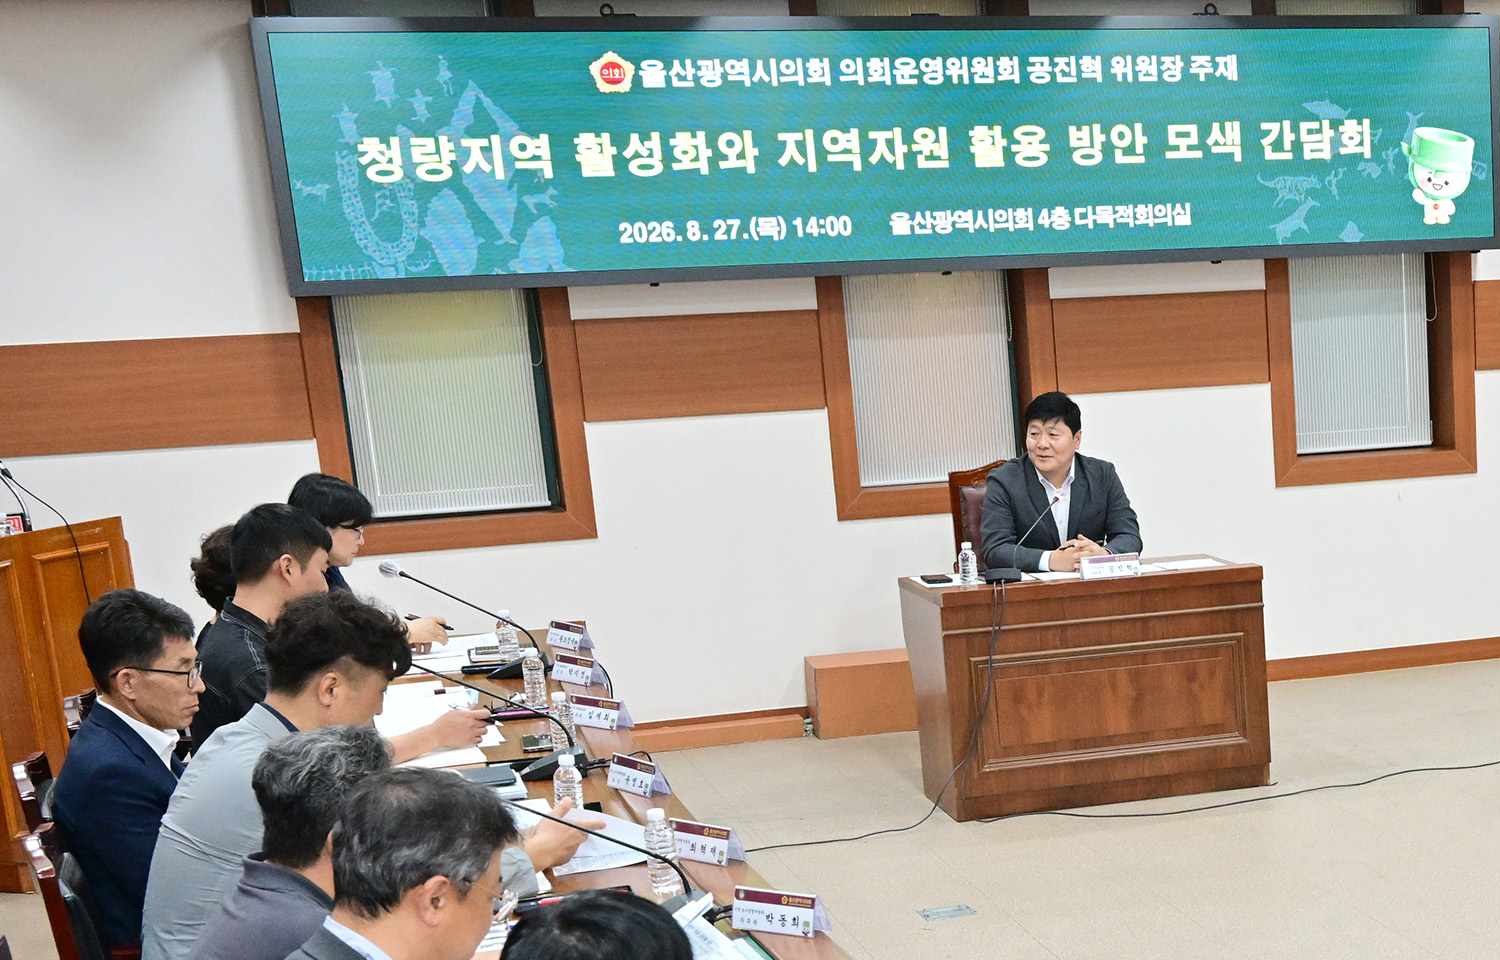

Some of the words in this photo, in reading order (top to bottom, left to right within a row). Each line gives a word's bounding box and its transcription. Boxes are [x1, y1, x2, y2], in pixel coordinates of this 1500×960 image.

[601, 67, 624, 80] 의회
[639, 57, 831, 88] 울산광역시의회
[839, 56, 1020, 86] 의회운영위원회
[1026, 55, 1103, 84] 공진혁
[1110, 54, 1183, 82] 위원장
[1189, 54, 1239, 81] 주재
[357, 133, 554, 183] 청량지역
[573, 130, 759, 177] 활성화와
[777, 126, 949, 172] 지역자원
[968, 124, 1051, 168] 활용
[1068, 122, 1148, 166] 방안
[1165, 120, 1243, 162] 모색
[1260, 118, 1372, 160] 간담회
[793, 215, 852, 237] 14:00
[889, 207, 1035, 236] 울산광역시의회
[1038, 206, 1072, 231] 4층
[1074, 203, 1192, 229] 다목적회의실
